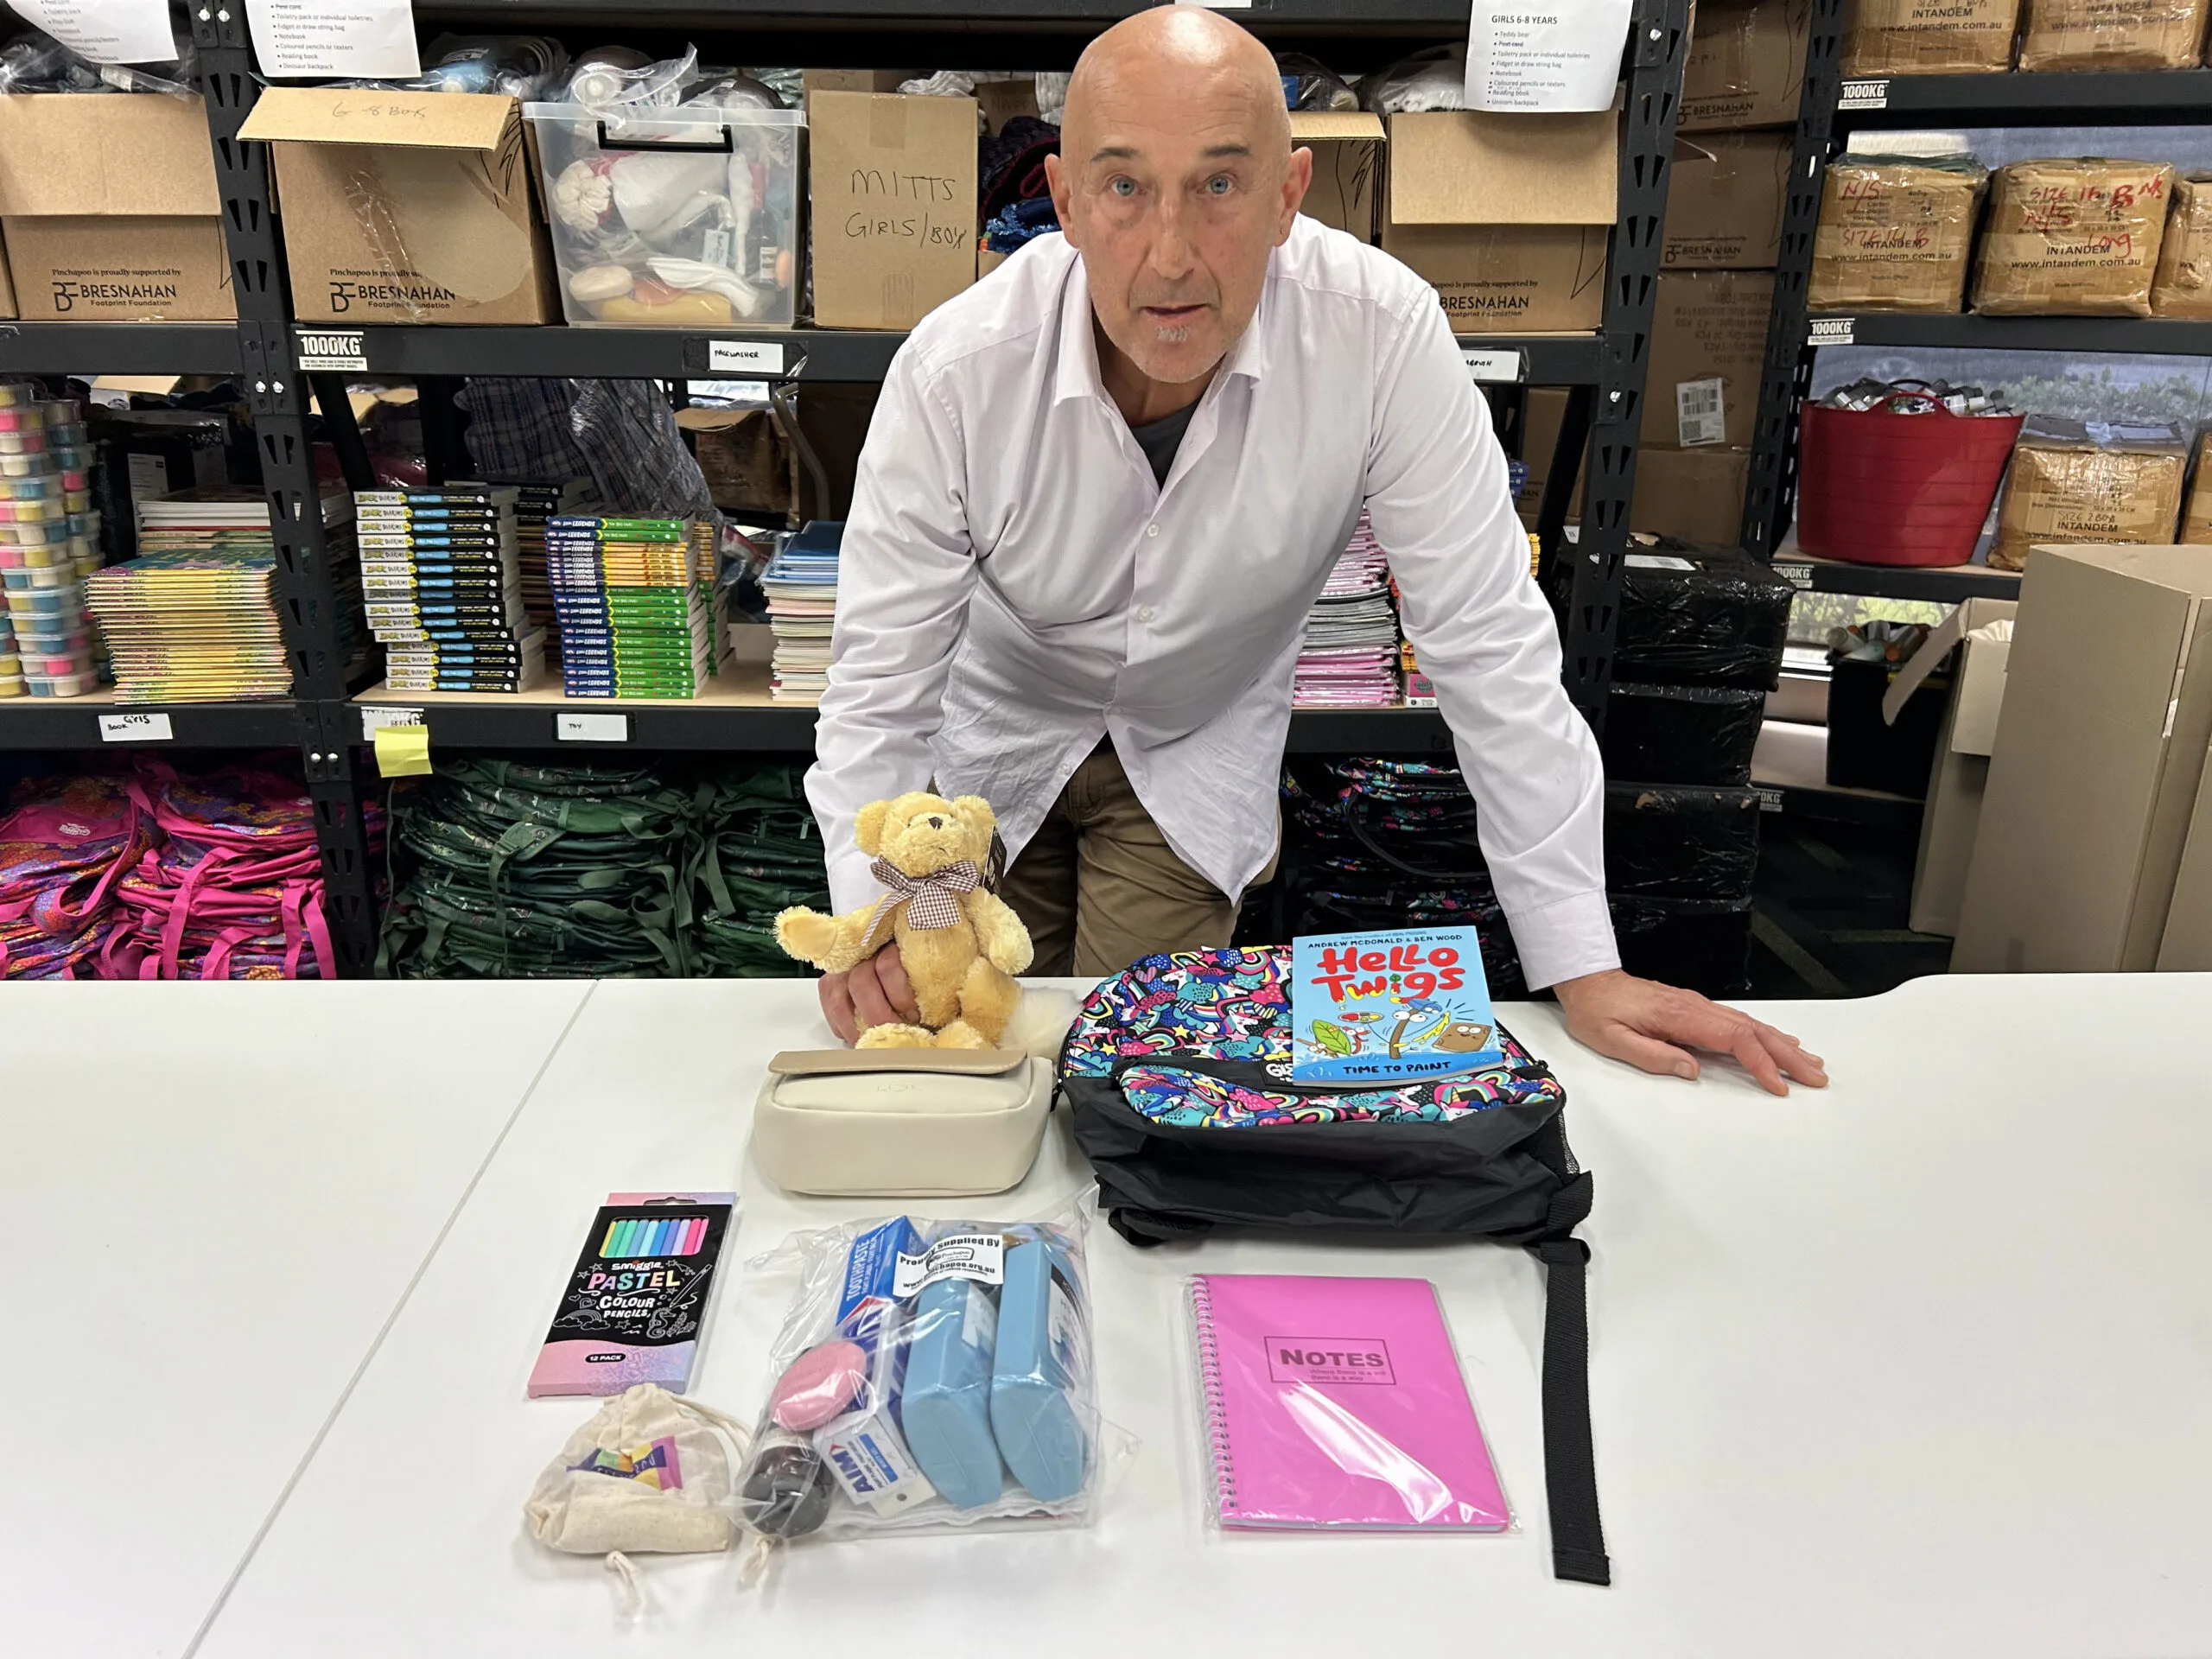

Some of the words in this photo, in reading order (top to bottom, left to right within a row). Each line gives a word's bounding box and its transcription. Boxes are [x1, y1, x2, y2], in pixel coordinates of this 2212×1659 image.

[1912, 8, 1973, 18] INTANDEM
[2087, 2, 2152, 14] INTANDEM
[1491, 15, 1515, 23] GIRLS
[1516, 16, 1529, 24] 6-8
[1532, 16, 1558, 25] YEARS
[1880, 22, 2002, 32] www.intandem.com.au
[1694, 103, 1753, 116] BRESNAHAN
[852, 169, 956, 202] MITTS
[1841, 180, 1882, 212] N/S
[2031, 187, 2068, 200] SIZE
[2112, 185, 2134, 209] B
[1843, 229, 1881, 246] SIZE
[1864, 240, 1922, 249] INTANDEM
[2047, 245, 2110, 256] INTANDEM
[1831, 252, 1952, 263] www.intandem.com.au
[2012, 258, 2140, 270] www.intandem.com.au
[330, 269, 371, 278] Pinchapoo
[1463, 281, 1490, 289] proudly
[1491, 280, 1529, 289] supported
[80, 284, 177, 298] BRESNAHAN
[359, 285, 455, 301] BRESNAHAN
[1440, 296, 1529, 310] BRESNAHAN
[2057, 522, 2118, 532] INTANDEM
[1344, 1065, 1379, 1075] TIME
[1384, 1065, 1402, 1073] TO
[1407, 1061, 1452, 1072] PAINT
[938, 1237, 984, 1249] Supplied
[987, 1237, 1000, 1248] By
[611, 1261, 664, 1271] smiggle
[847, 1239, 870, 1301] TOOTHPASTE
[588, 1270, 680, 1290] PASTEL
[600, 1296, 655, 1309] COLOUR
[604, 1309, 648, 1319] PENCILS
[1280, 1349, 1384, 1367] NOTES
[831, 1450, 875, 1493] AIM
